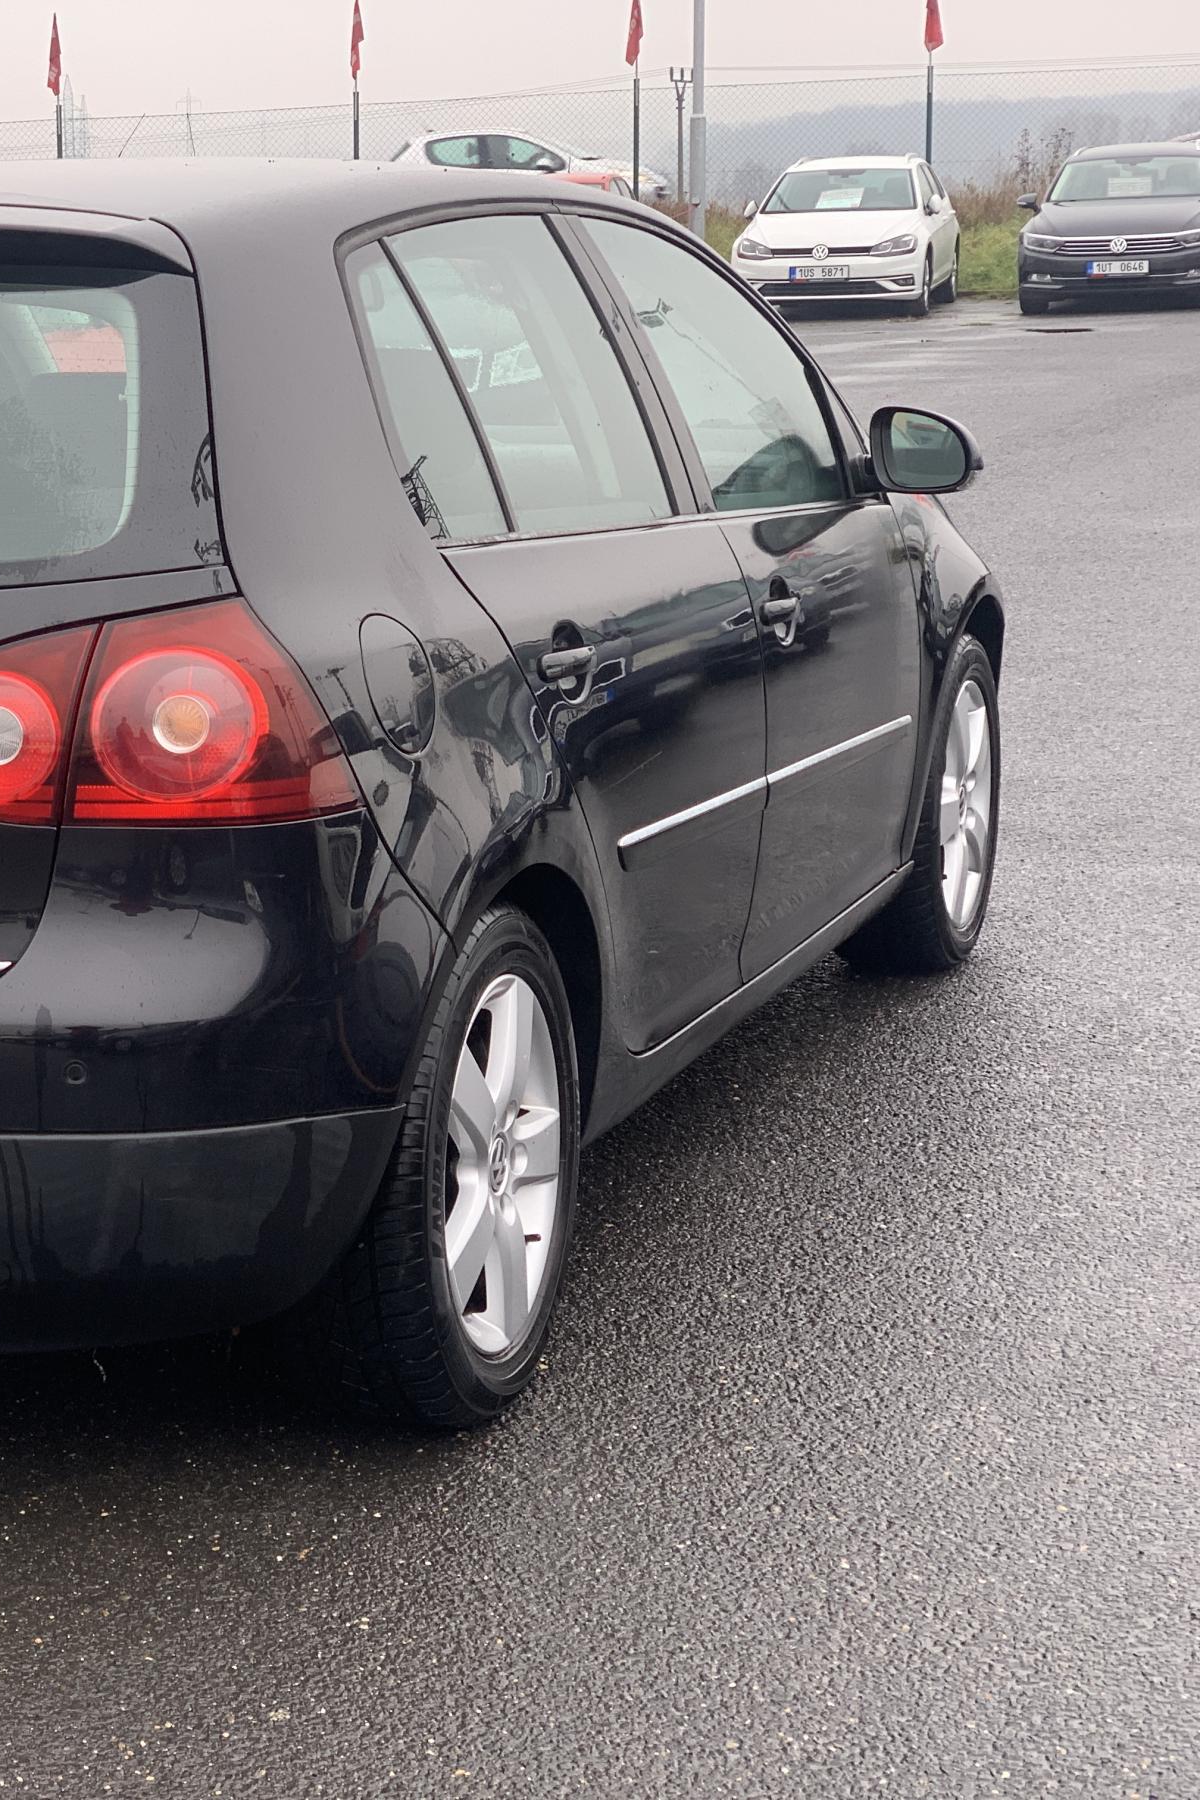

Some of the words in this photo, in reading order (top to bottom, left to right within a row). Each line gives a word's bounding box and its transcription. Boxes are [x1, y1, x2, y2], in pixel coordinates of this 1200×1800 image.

[798, 268, 815, 278] 1US
[821, 267, 844, 277] 5871
[1096, 263, 1113, 273] 1UT
[1120, 261, 1144, 272] 0646
